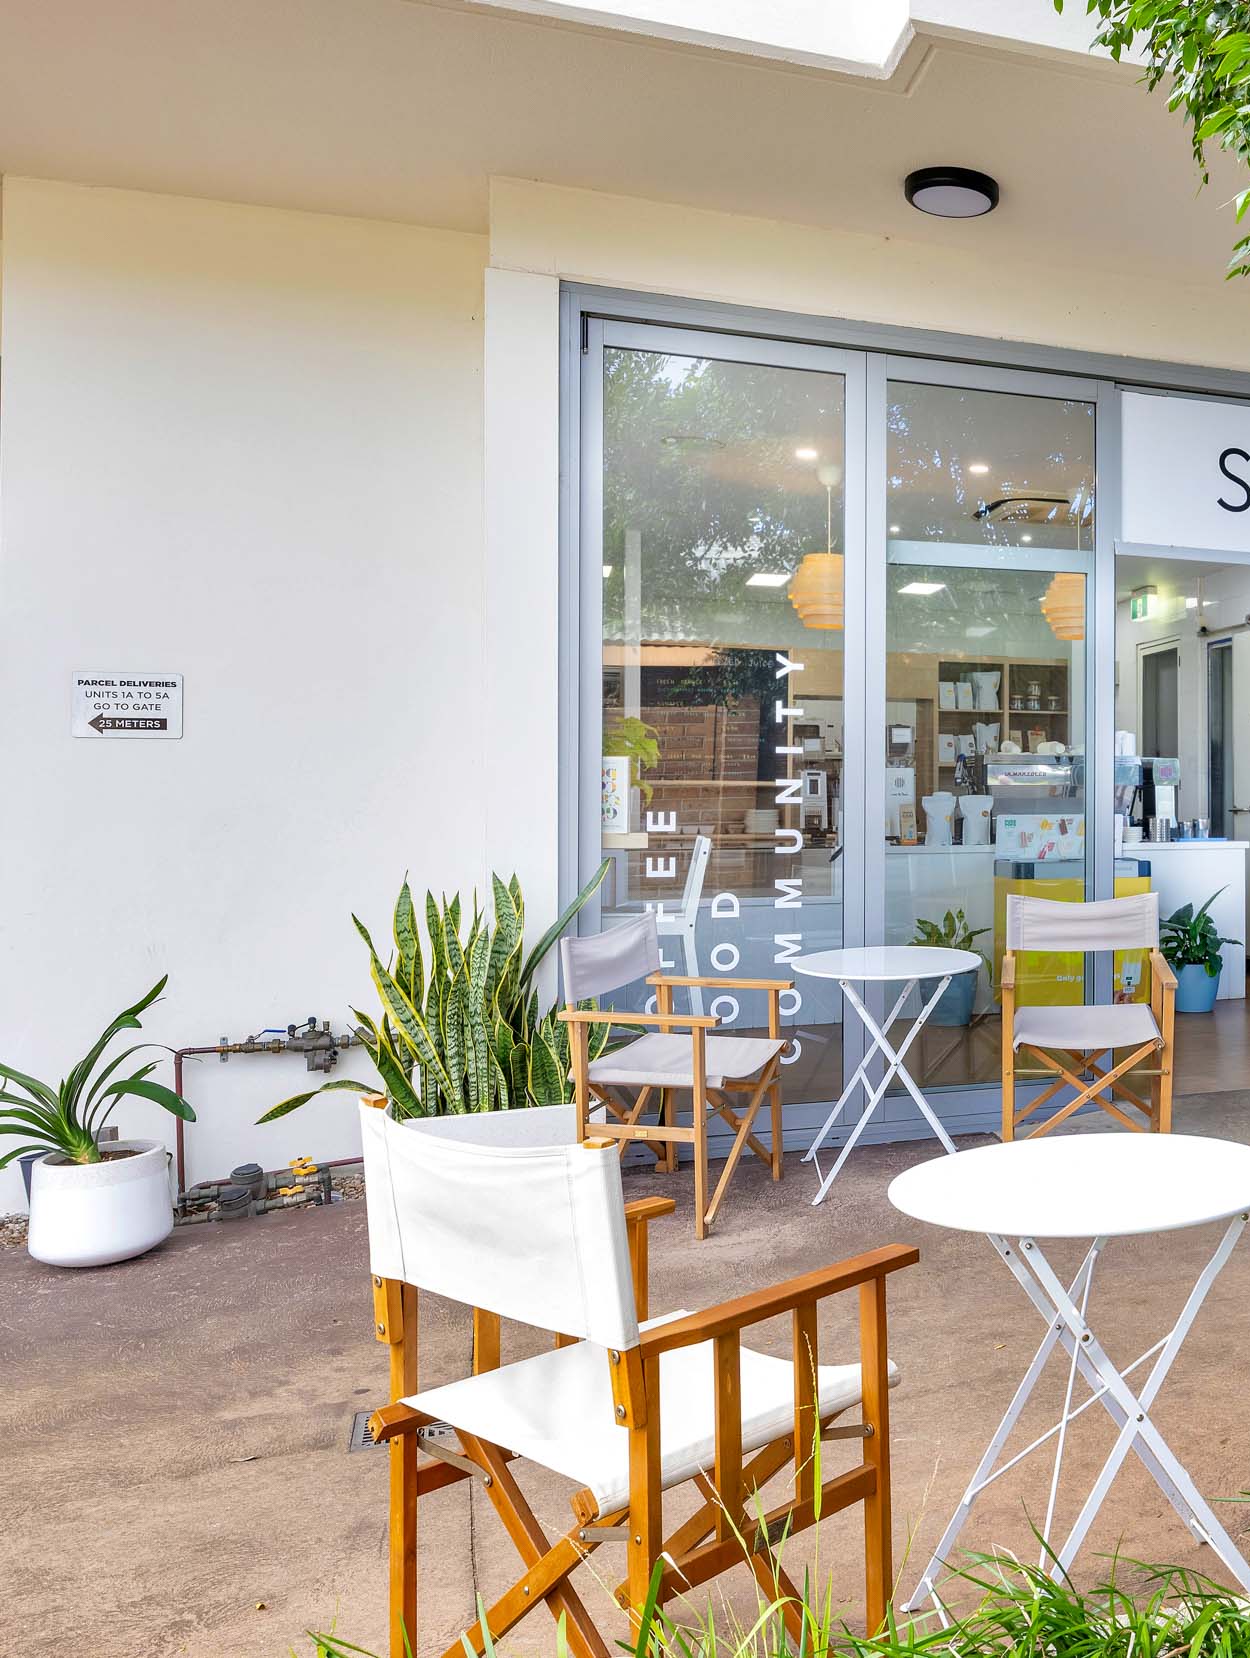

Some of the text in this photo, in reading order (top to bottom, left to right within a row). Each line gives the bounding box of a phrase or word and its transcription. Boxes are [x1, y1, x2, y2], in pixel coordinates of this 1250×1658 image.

[77, 679, 177, 688] PARCEL DELIVERIES
[85, 691, 170, 700] UNITS 1A TO 5A
[93, 703, 162, 711] GO TO GATE
[98, 720, 161, 728] 25 METERS
[710, 892, 740, 1024] OOD
